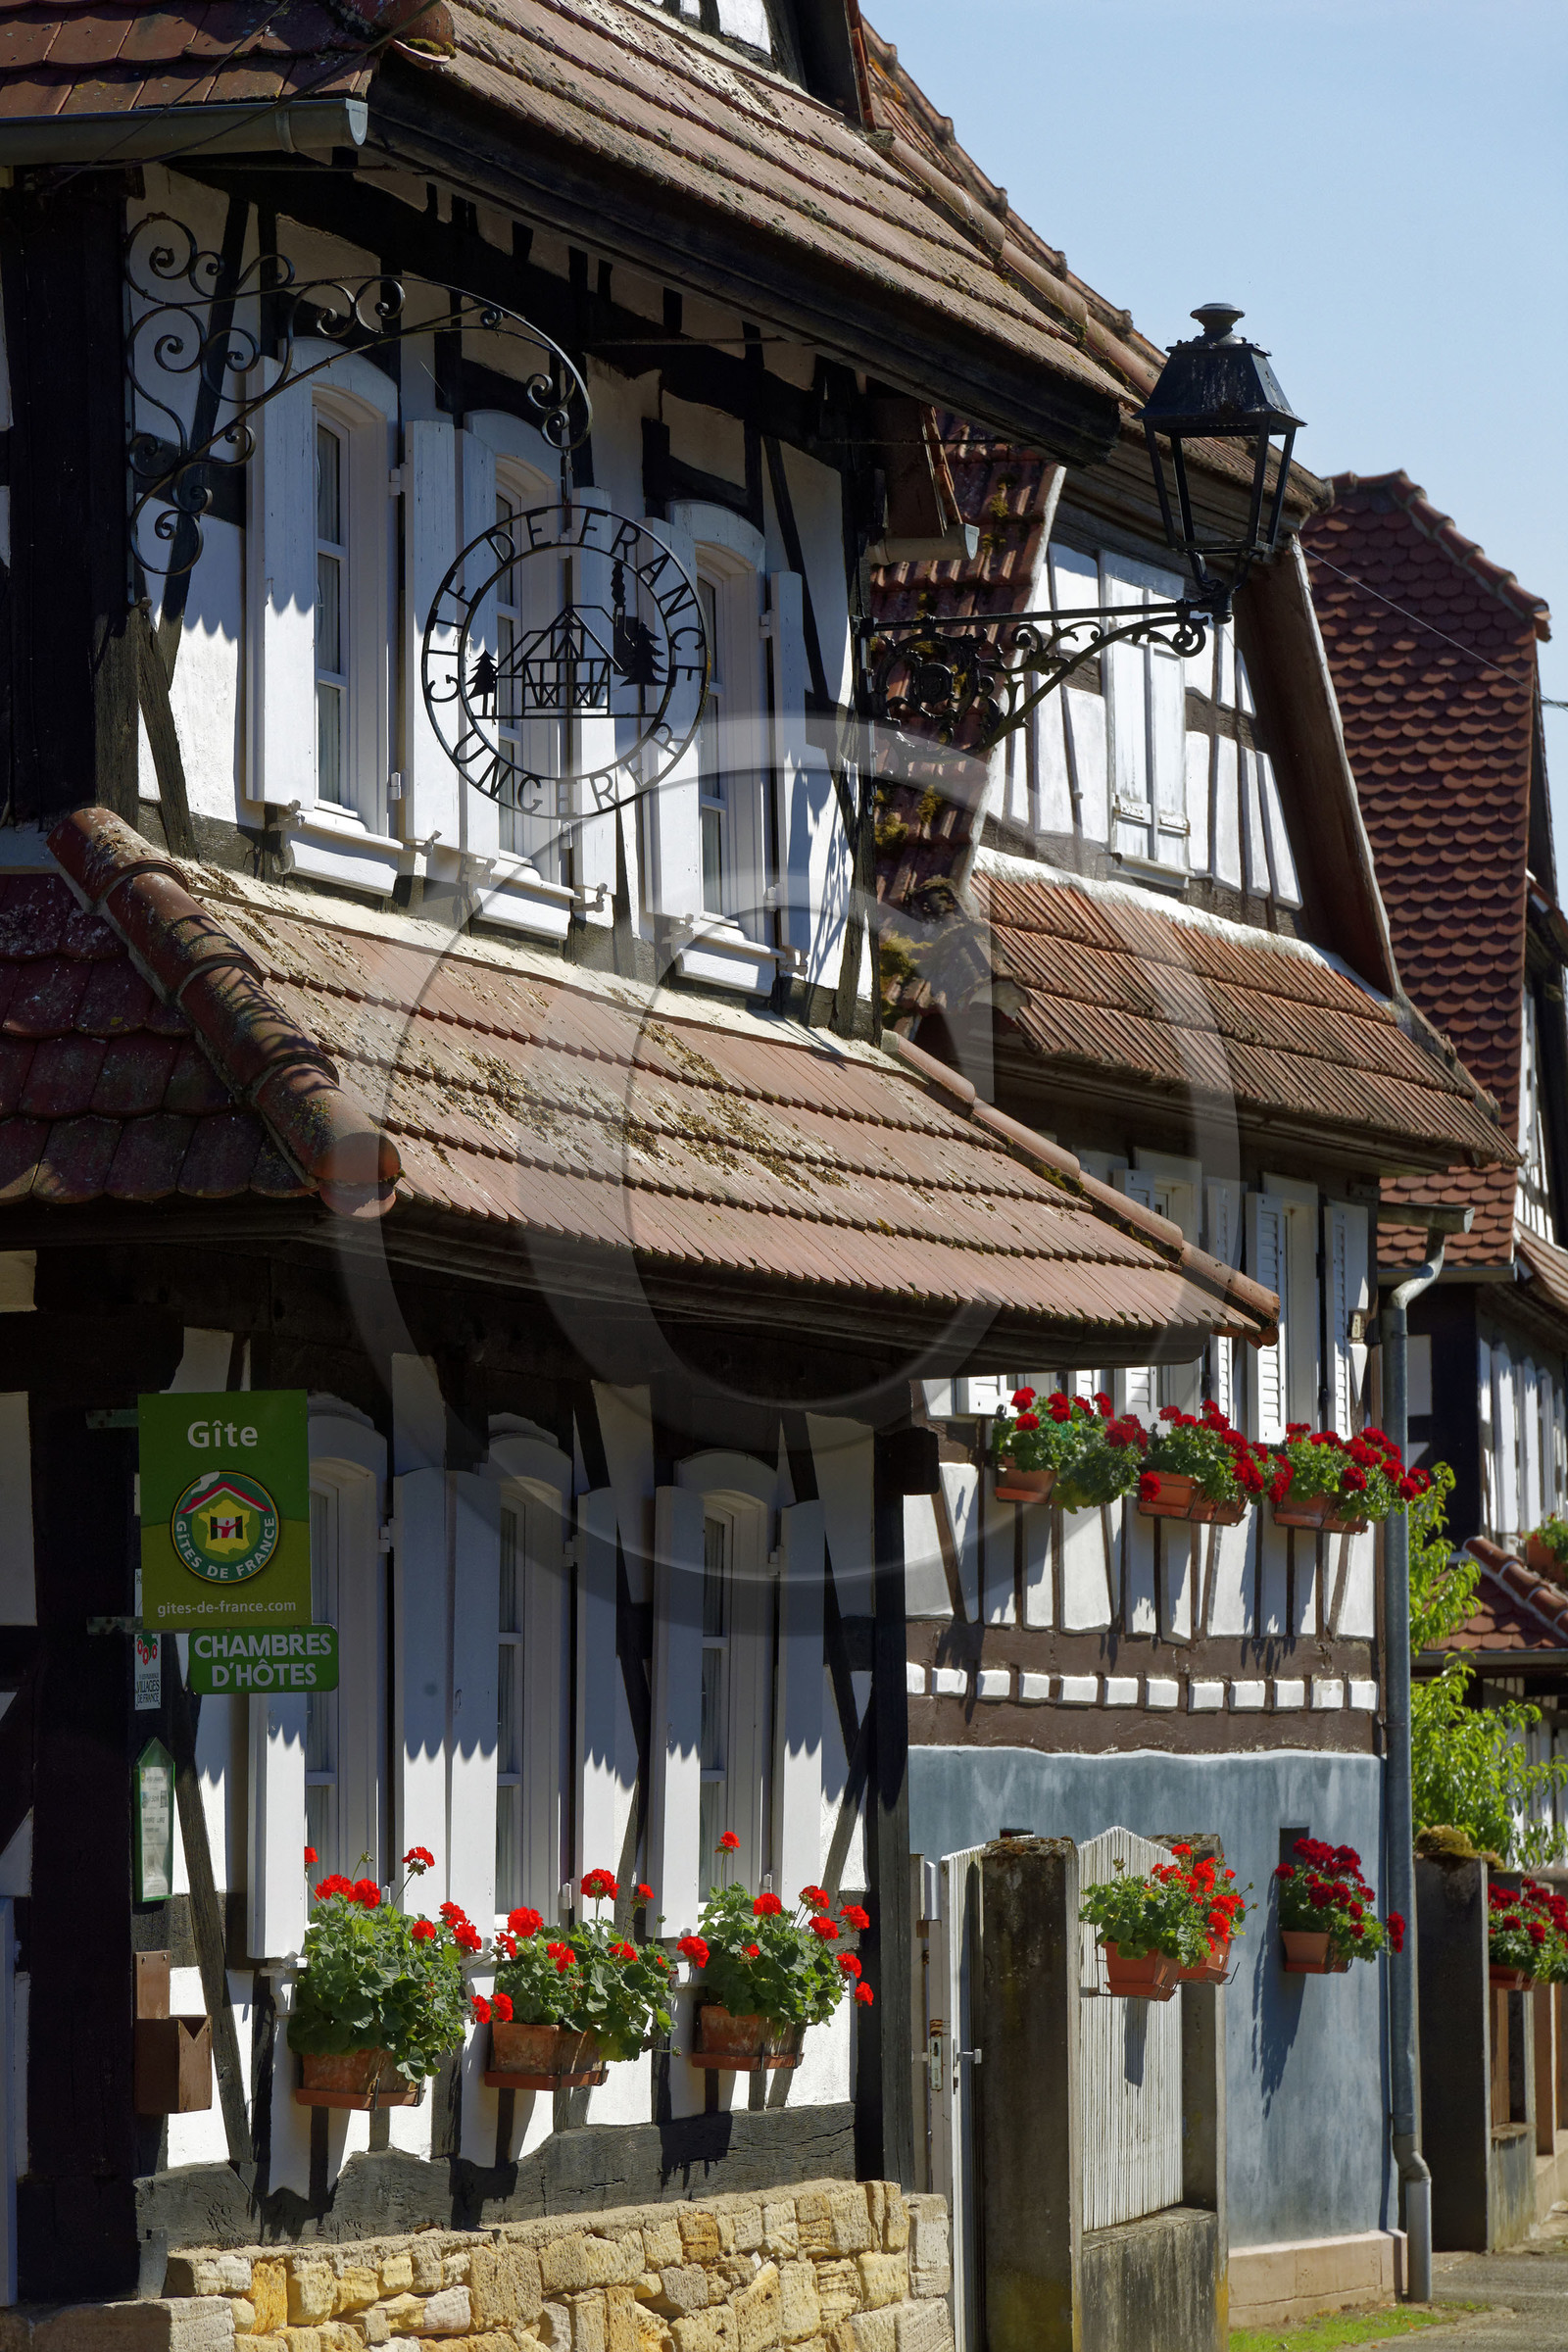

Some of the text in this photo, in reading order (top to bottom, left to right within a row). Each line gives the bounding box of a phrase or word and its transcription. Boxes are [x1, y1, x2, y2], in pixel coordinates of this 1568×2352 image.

[425, 508, 708, 704] GITE DE FRANCE
[451, 721, 686, 819] UNGERER
[187, 1420, 259, 1448] Gîte
[206, 1564, 229, 1579] DE
[235, 1517, 275, 1577] FRANCE
[157, 1600, 297, 1617] gites-de-france.com
[194, 1633, 332, 1658] CHAMBRES
[211, 1658, 318, 1688] D'HÔTES
